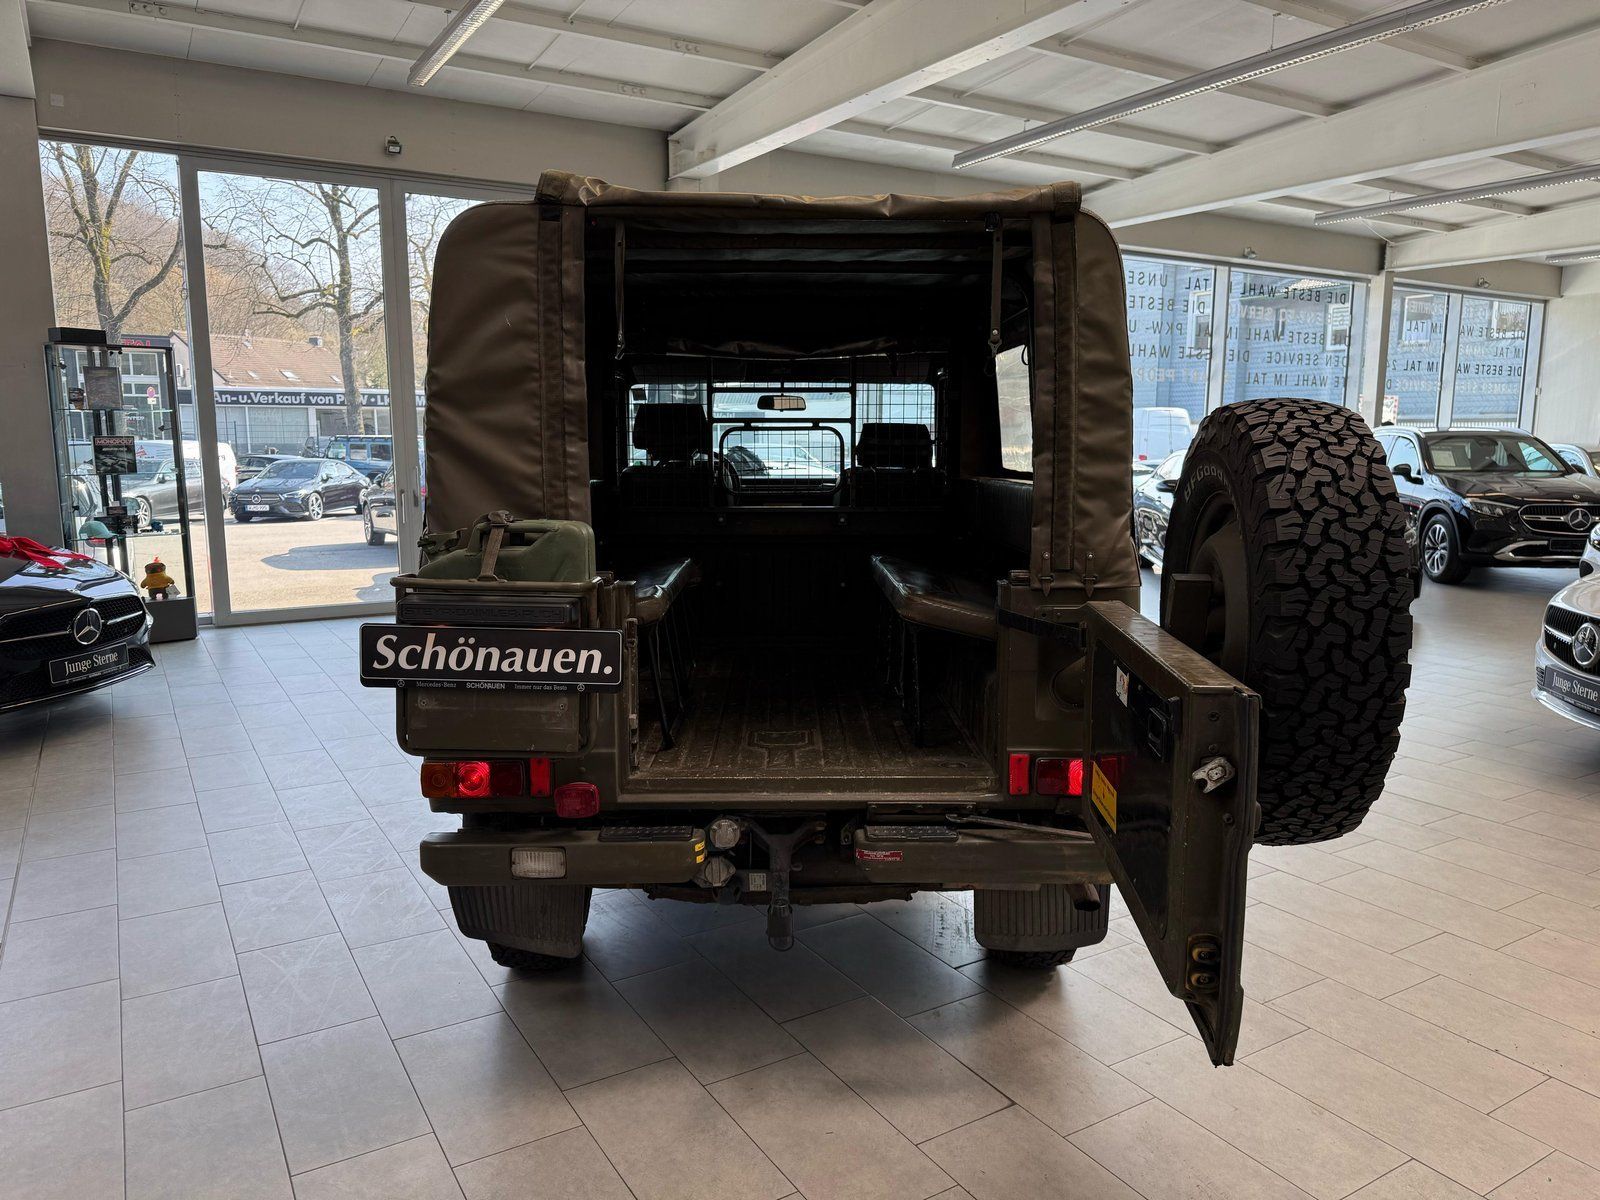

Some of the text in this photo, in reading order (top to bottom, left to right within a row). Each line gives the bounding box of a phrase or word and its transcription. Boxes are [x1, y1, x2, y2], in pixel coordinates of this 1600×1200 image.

[309, 395, 334, 404] von
[64, 660, 92, 676] Junge
[92, 652, 119, 667] Sterne
[372, 632, 613, 676] Schönauen.
[1552, 672, 1598, 701] Junge Sterne
